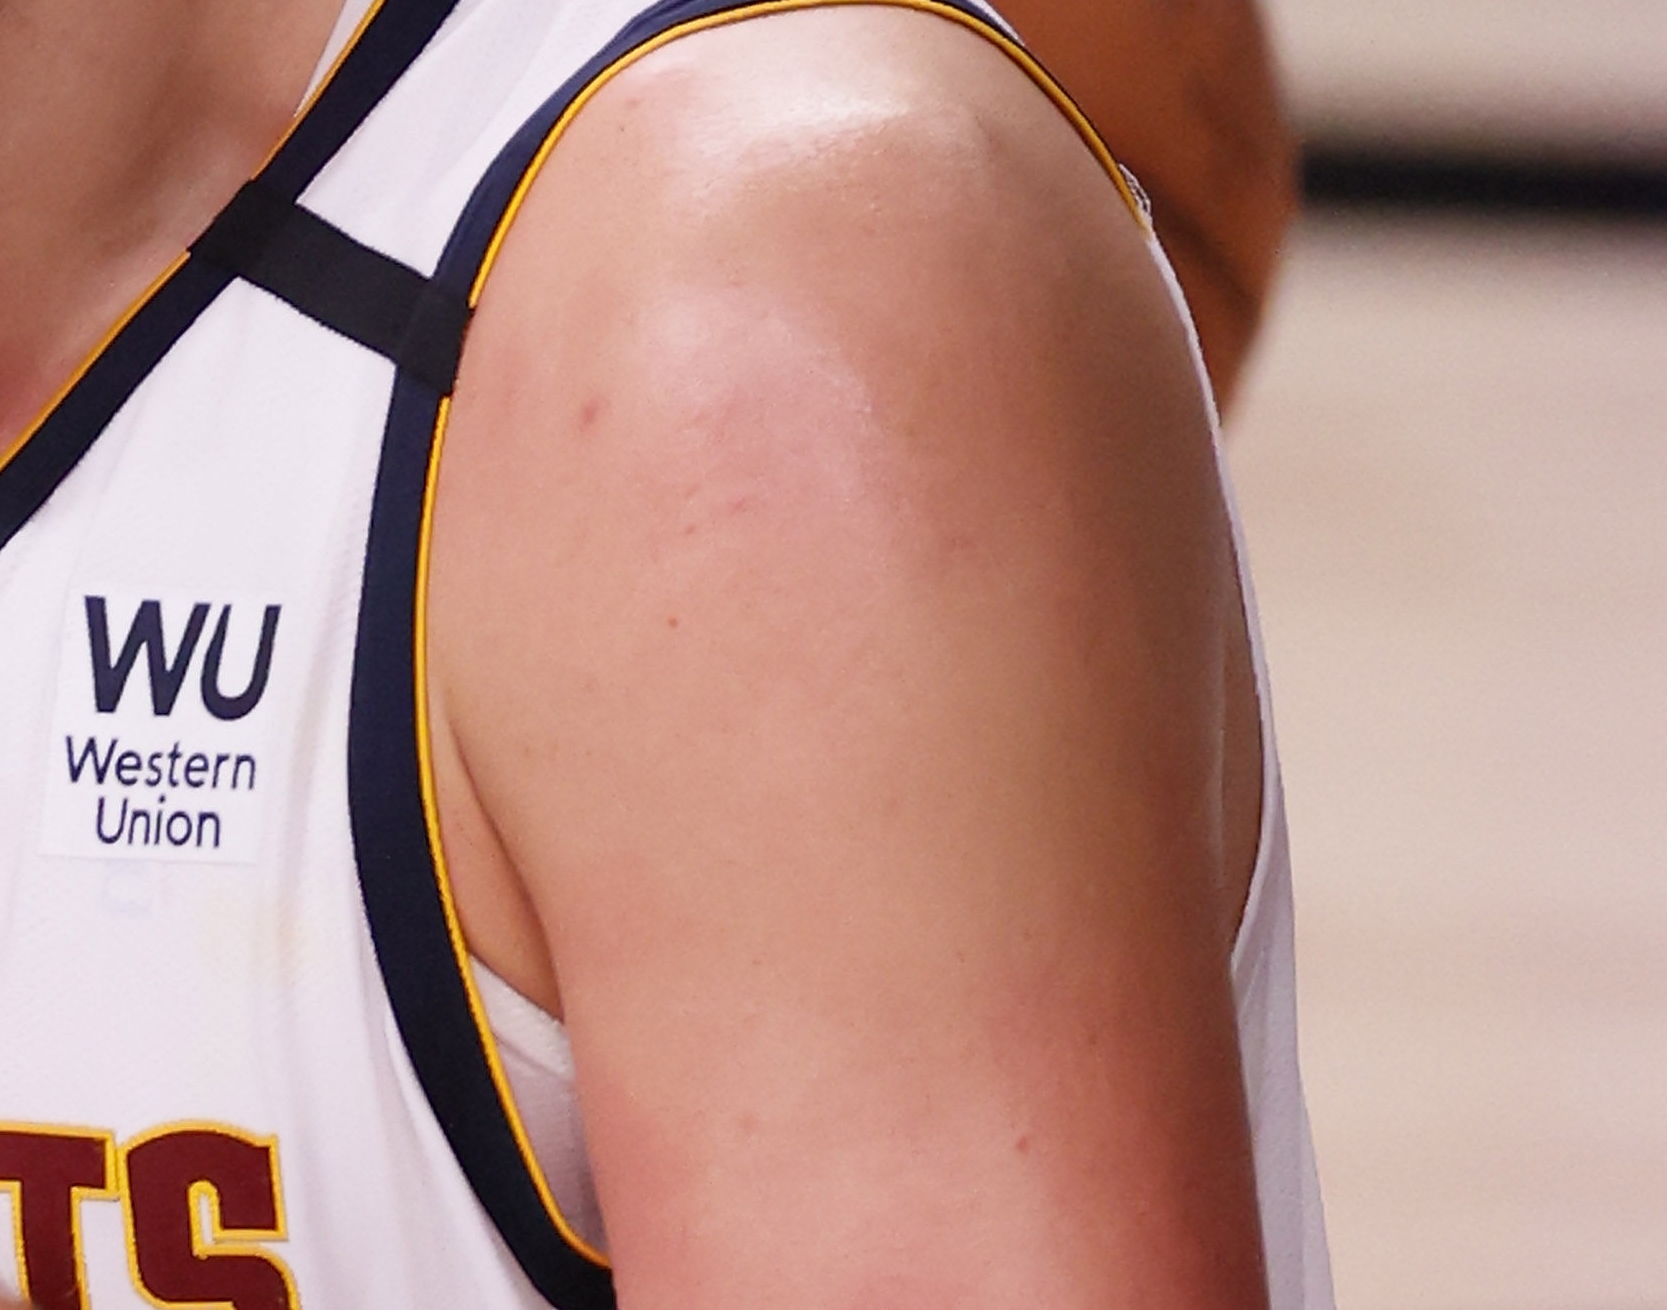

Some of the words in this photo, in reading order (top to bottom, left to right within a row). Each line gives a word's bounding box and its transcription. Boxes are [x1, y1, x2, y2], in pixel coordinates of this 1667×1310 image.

[84, 594, 282, 721] WU
[65, 734, 257, 791] Western
[95, 794, 222, 849] Union
